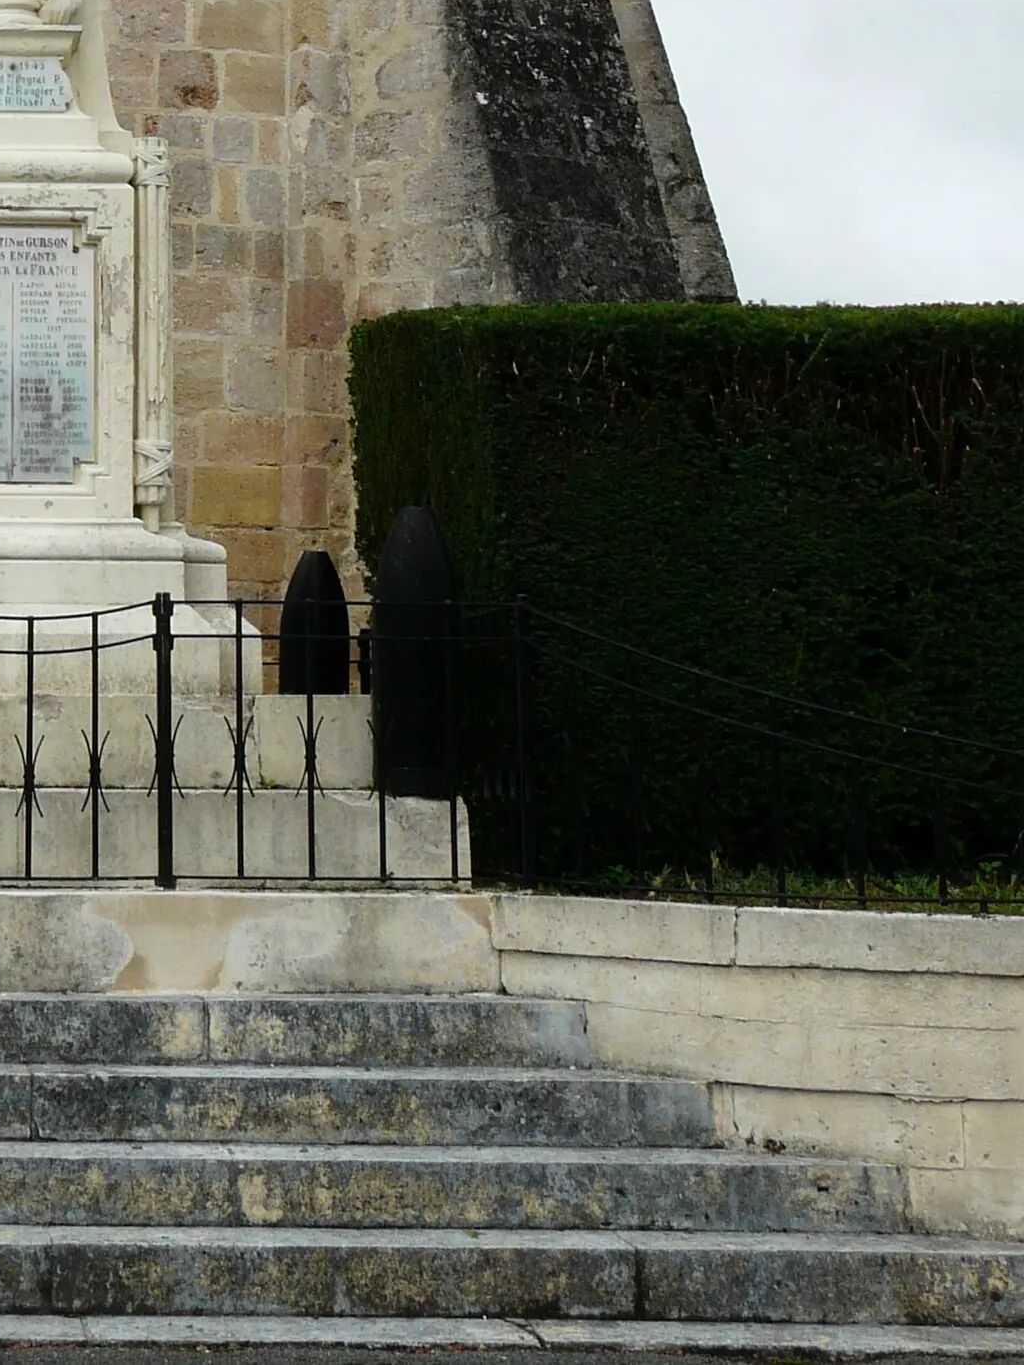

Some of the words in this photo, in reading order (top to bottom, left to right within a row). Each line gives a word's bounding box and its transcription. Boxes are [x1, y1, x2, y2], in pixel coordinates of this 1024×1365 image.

[26, 237, 68, 248] GURSON
[10, 251, 57, 262] ENFANTS
[30, 264, 78, 276] FRANCE
